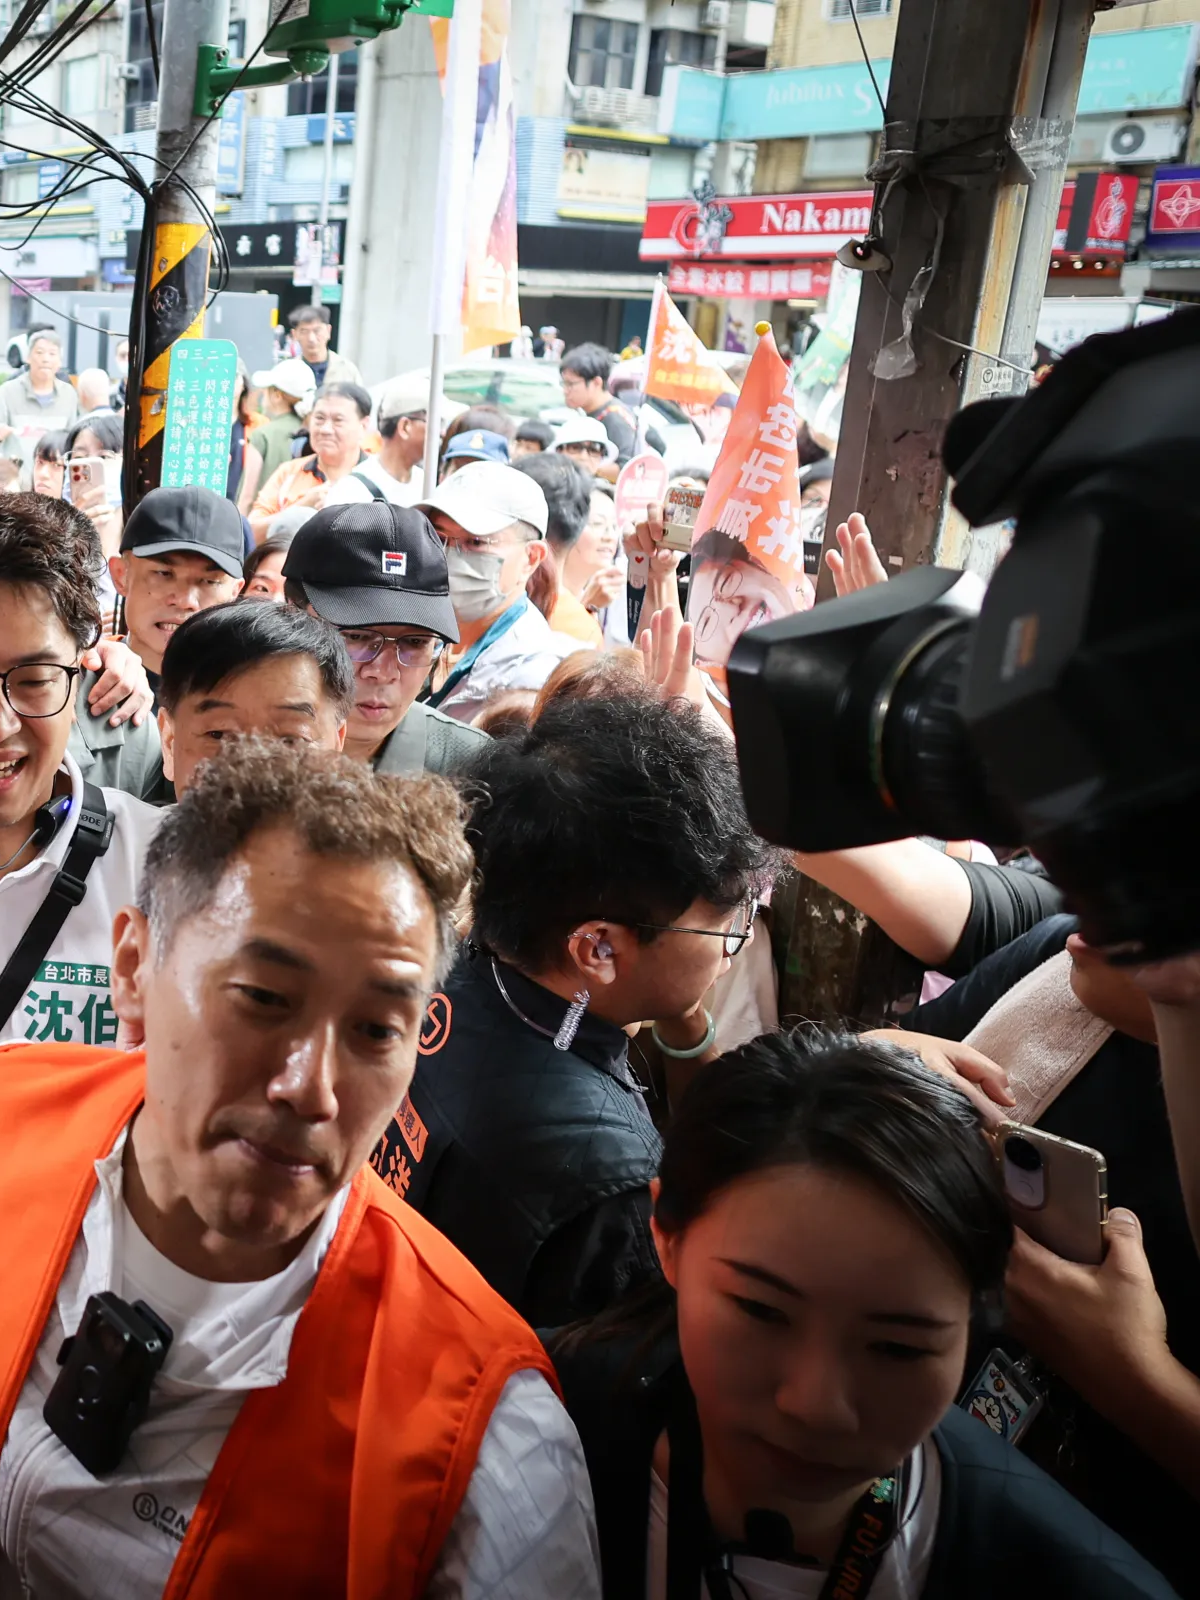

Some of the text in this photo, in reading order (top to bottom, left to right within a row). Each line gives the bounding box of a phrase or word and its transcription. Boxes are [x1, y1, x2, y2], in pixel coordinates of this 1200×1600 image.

[79, 814, 101, 826] ØDE
[44, 964, 108, 985] 台北市長
[23, 990, 119, 1045] 沈伯
